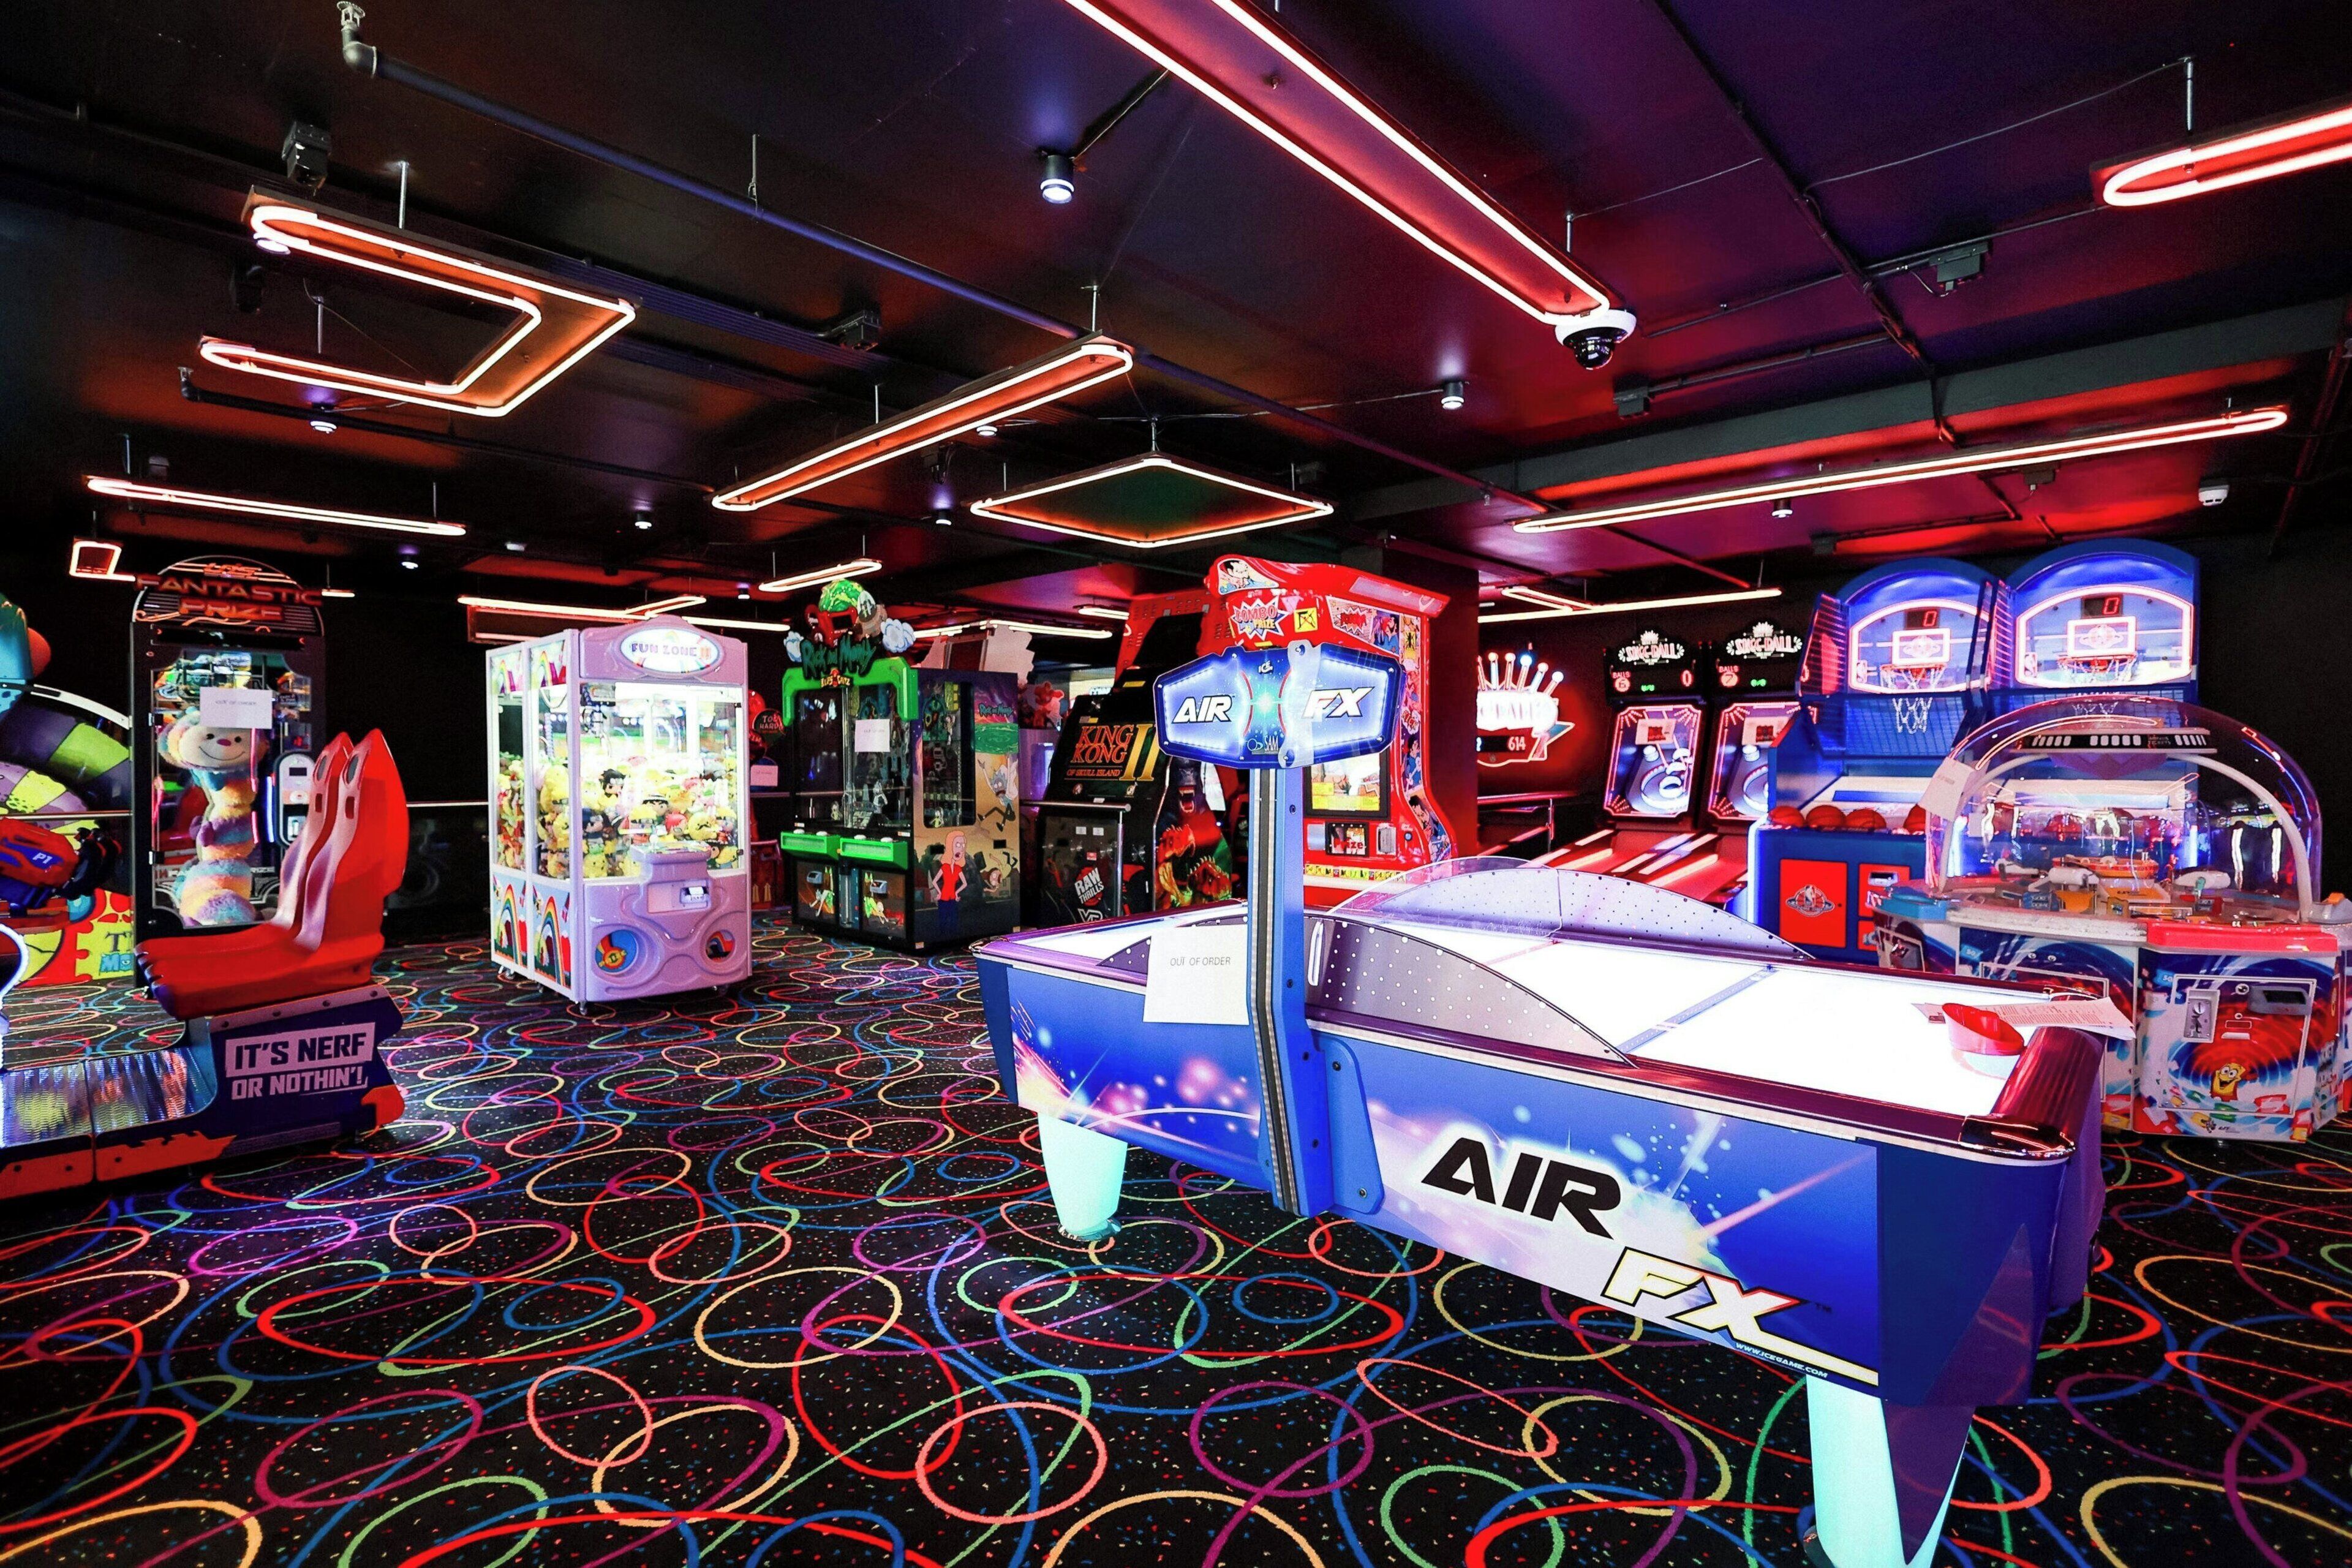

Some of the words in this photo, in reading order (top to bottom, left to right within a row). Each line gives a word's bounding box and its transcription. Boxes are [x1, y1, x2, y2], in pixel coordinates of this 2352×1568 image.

[135, 575, 323, 606] FANTASTIC
[179, 597, 285, 621] PRIZE
[1235, 605, 1278, 623] COMBO
[2103, 597, 2120, 614] 0
[1253, 619, 1276, 629] PRIZE
[1923, 611, 1938, 627] 0
[631, 643, 659, 654] FUN
[1257, 660, 1274, 673] ICE
[1681, 669, 1694, 687] 0
[1171, 693, 1233, 724] AIR
[1302, 685, 1376, 723] FX
[1077, 724, 1134, 747] KING
[1264, 734, 1280, 752] SAM
[1508, 736, 1526, 752] 614
[1070, 742, 1128, 764] KONG
[32, 852, 53, 864] P1
[1074, 867, 1101, 895] RAW
[1078, 881, 1104, 904] THRILLS
[1170, 957, 1186, 966] OUT
[1189, 957, 1200, 966] OF
[1202, 957, 1231, 966] ORDER
[235, 1041, 289, 1070] IT'S
[298, 1032, 367, 1063] NERF
[232, 1077, 263, 1100] OR
[270, 1066, 363, 1096] NOTHIN'!
[1420, 1137, 1621, 1240] AIR
[1600, 1246, 1828, 1355] FX
